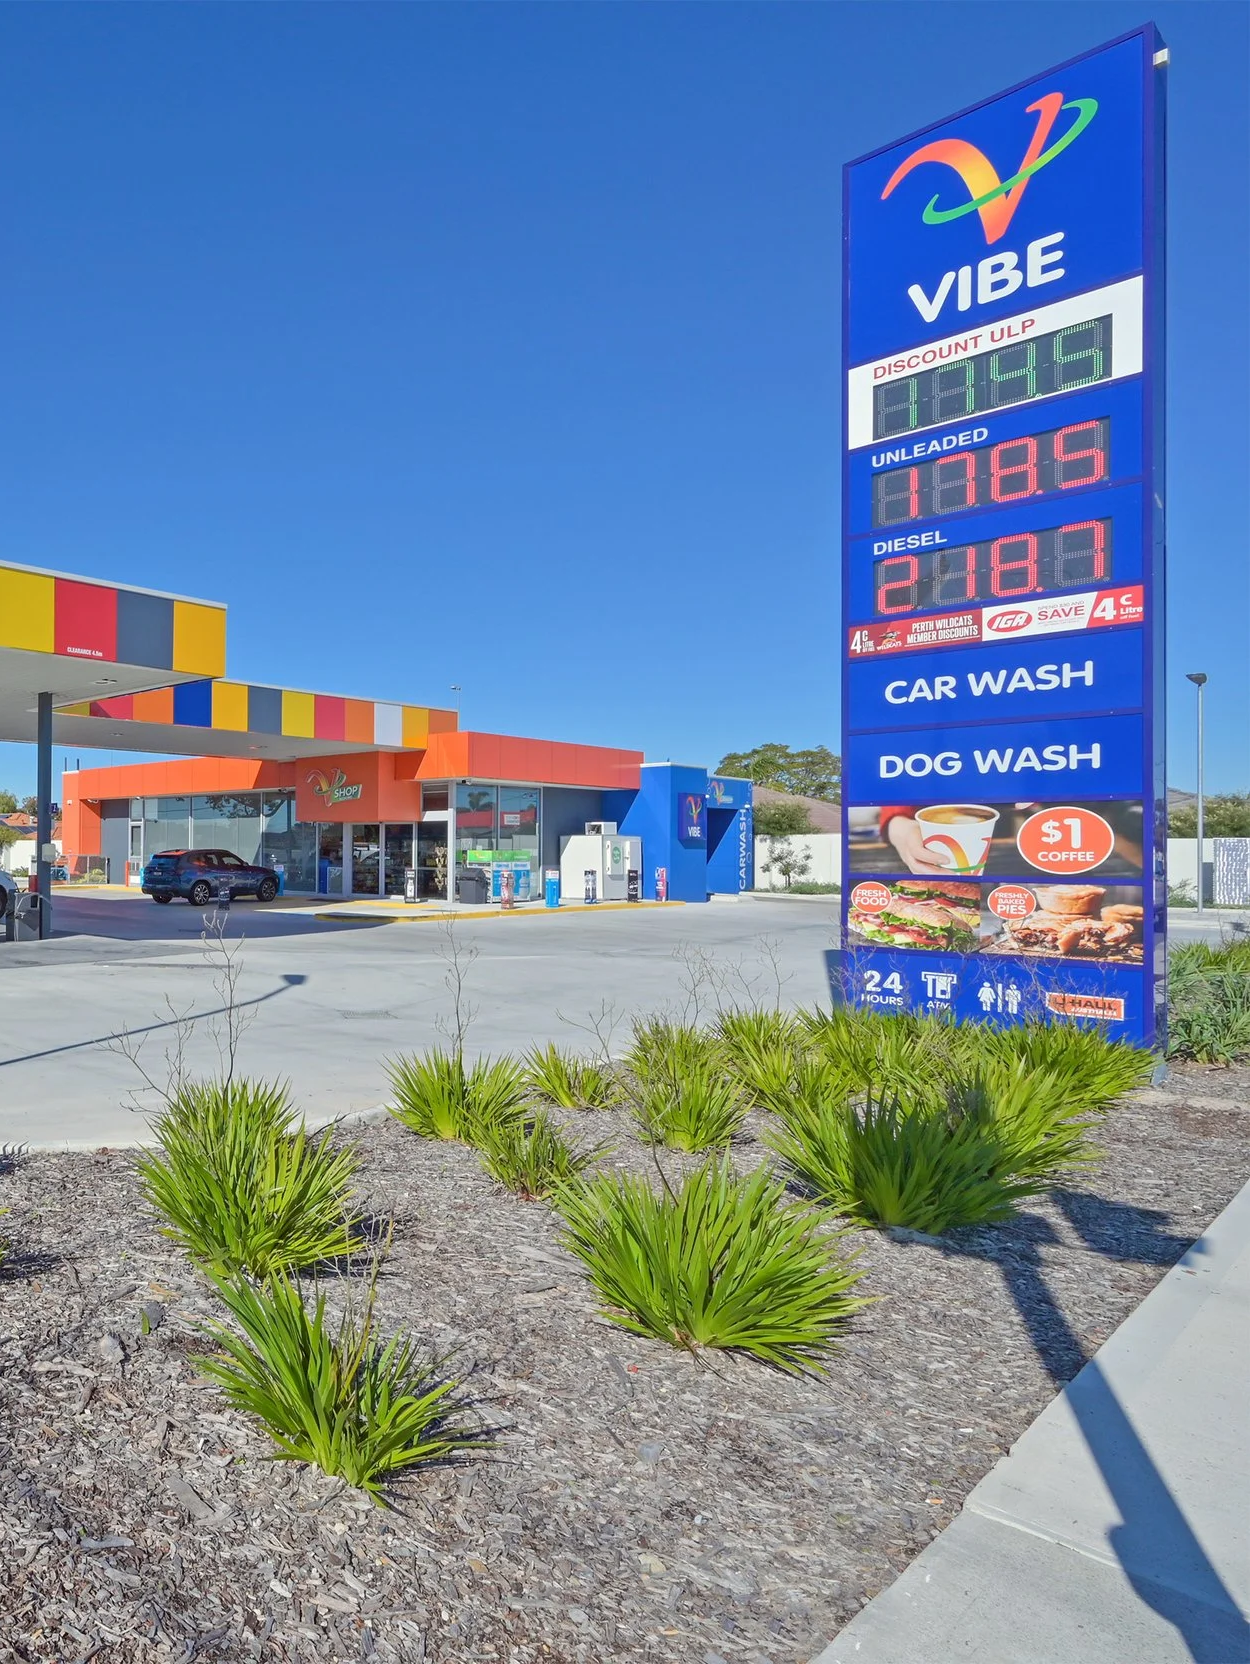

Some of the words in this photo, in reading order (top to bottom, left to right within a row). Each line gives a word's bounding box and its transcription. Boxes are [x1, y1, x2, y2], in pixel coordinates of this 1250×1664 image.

[907, 231, 1066, 323] VIBE
[873, 334, 983, 381] DISCOUNT
[989, 318, 1036, 345] ULP
[871, 427, 989, 469] UNLEADED
[873, 531, 948, 556] DIESEL
[1037, 605, 1085, 621] SAVE
[1093, 597, 1117, 621] 4
[1120, 606, 1143, 614] Litre
[911, 621, 934, 633] PERTH
[935, 615, 973, 629] WILDCATS
[992, 613, 1026, 630] IGA
[850, 630, 862, 653] 4
[906, 632, 937, 644] MEMBER
[938, 625, 978, 640] DISCOUNTS
[884, 675, 957, 705] CAR
[967, 660, 1094, 697] WASH
[879, 751, 963, 778] DOG
[973, 742, 1101, 774] WASH
[334, 786, 358, 798] SHOP
[687, 826, 701, 838] VIBE
[1041, 817, 1082, 849] $1
[739, 808, 747, 890] CARWASH
[1037, 851, 1095, 862] COFFEE
[854, 896, 889, 906] FOOD
[856, 888, 887, 898] FRESH
[994, 891, 1029, 900] FRESHLY
[997, 898, 1026, 906] BAKED
[996, 904, 1027, 915] PIES
[864, 970, 904, 994] 24
[861, 993, 904, 1006] HOURS
